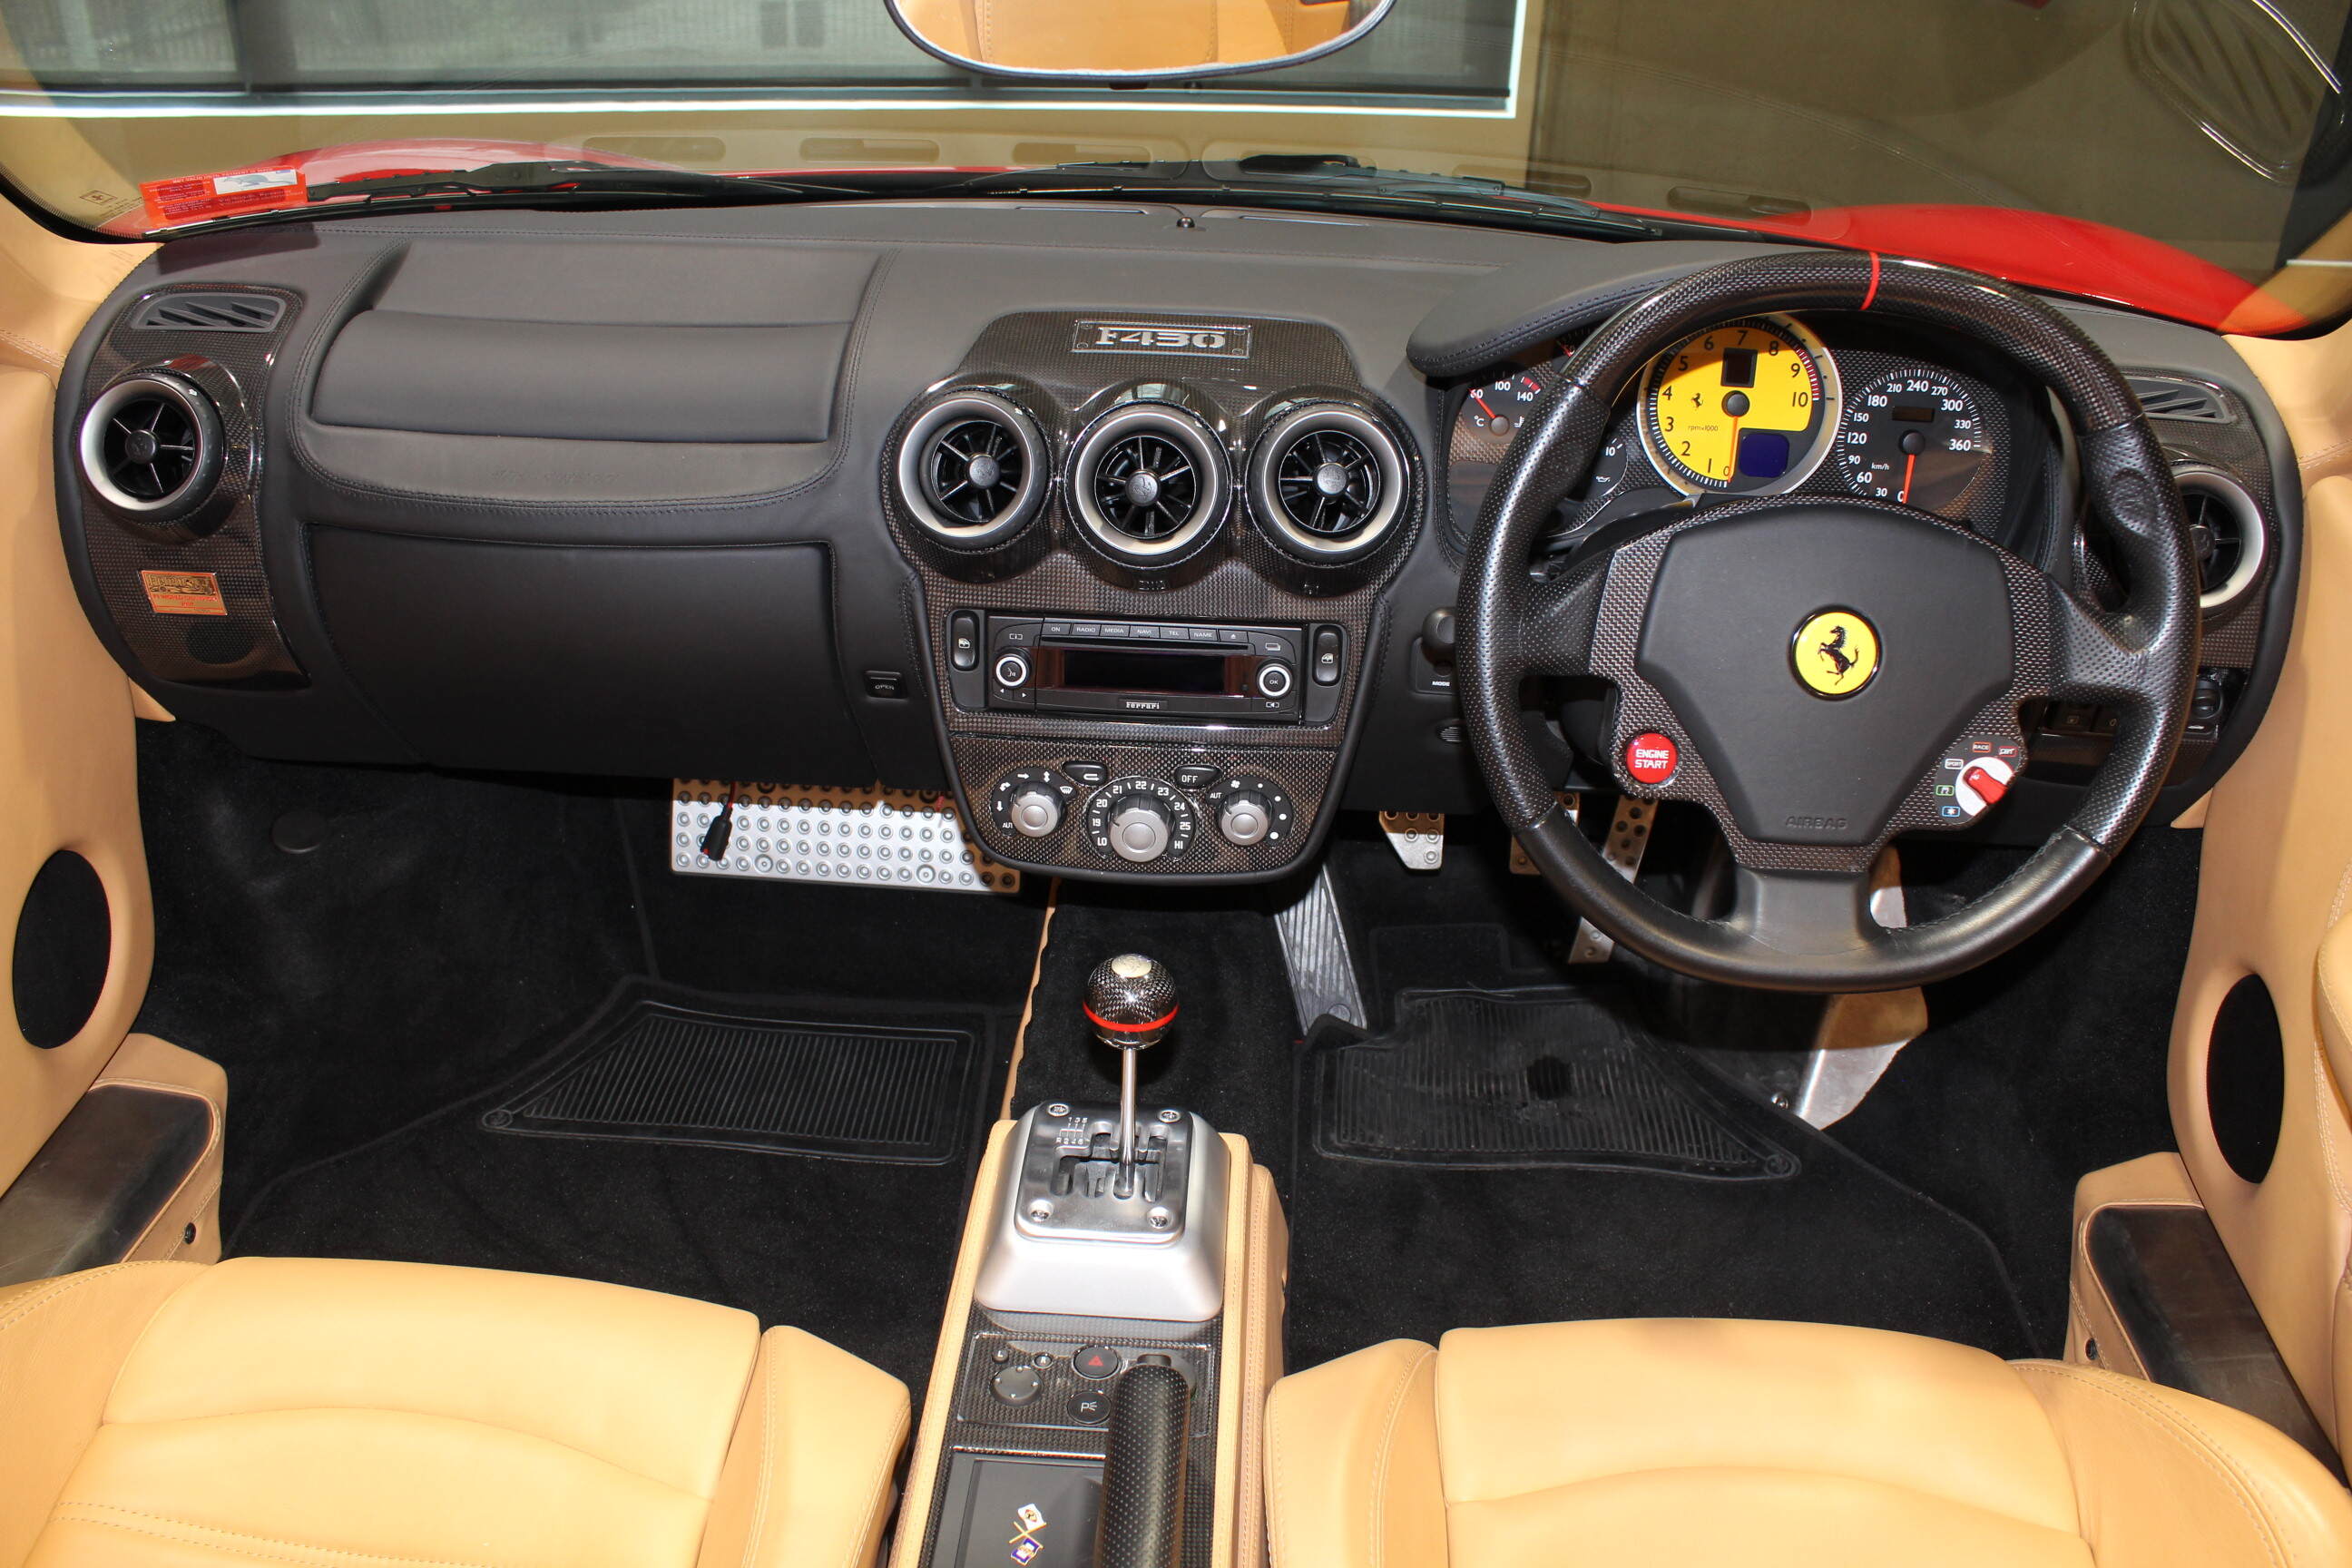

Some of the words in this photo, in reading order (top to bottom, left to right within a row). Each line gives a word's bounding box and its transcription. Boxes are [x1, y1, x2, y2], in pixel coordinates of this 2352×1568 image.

[1095, 327, 1226, 348] F430
[1704, 336, 1714, 350] 6
[1738, 329, 1749, 346] 7
[1769, 340, 1779, 356] 8
[1679, 355, 1689, 371] 5
[1790, 362, 1801, 378] 9
[1494, 381, 1511, 391] 100
[1886, 383, 1902, 393] 210
[1906, 379, 1929, 392] 240
[1517, 391, 1534, 402] 140
[1662, 386, 1672, 400] 4
[1931, 386, 1948, 397] 270
[1792, 391, 1808, 407] 10
[1867, 395, 1888, 407] 180
[1941, 399, 1963, 412] 300
[1853, 412, 1869, 423] 150
[1665, 416, 1675, 432] 3
[1955, 419, 1972, 429] 330
[1847, 432, 1867, 445] 120
[1681, 440, 1691, 456] 2
[1949, 439, 1972, 452] 360
[1605, 447, 1616, 456] 10
[1708, 458, 1712, 473] 1
[1848, 456, 1860, 465] 90
[1723, 466, 1731, 476] 0
[1871, 463, 1890, 471] km/h
[1857, 472, 1873, 484] 60
[1876, 487, 1888, 497] 30
[1126, 701, 1160, 710] Ferrari
[1635, 749, 1670, 760] ENGINE
[1634, 759, 1669, 769] START
[1181, 775, 1199, 784] OFF
[1112, 785, 1122, 795] 21
[1135, 781, 1147, 790] 22
[1158, 787, 1170, 796] 23
[1096, 799, 1108, 808] 20
[1174, 801, 1185, 812] 24
[1092, 818, 1102, 828] 19
[1180, 821, 1191, 830] 25
[1785, 816, 1848, 830] AIRBAG
[1097, 838, 1108, 848] LO
[1174, 840, 1184, 849] HI
